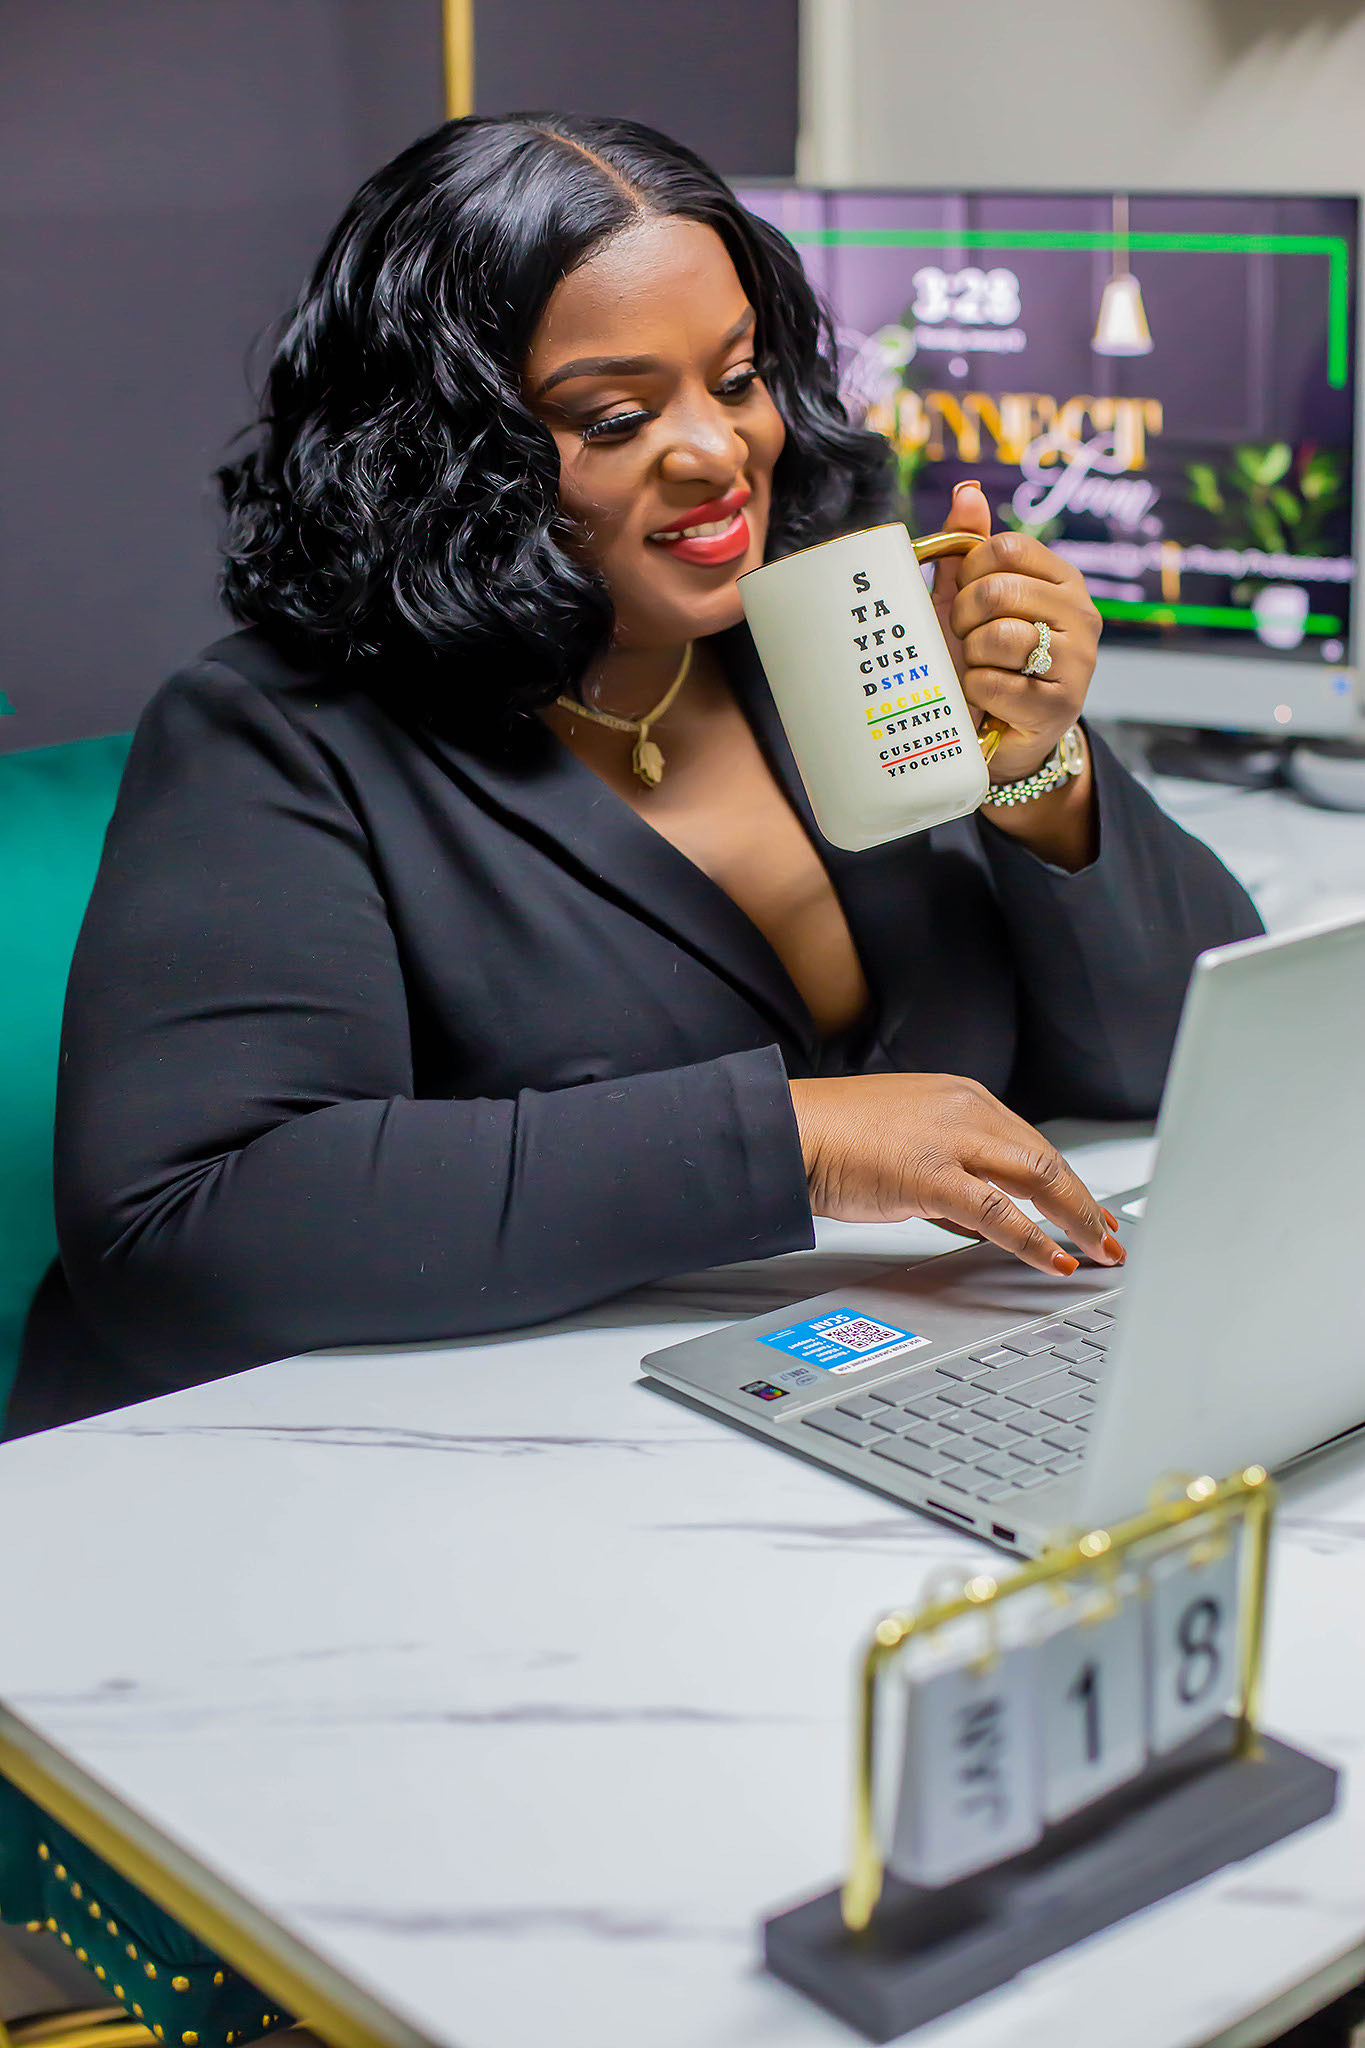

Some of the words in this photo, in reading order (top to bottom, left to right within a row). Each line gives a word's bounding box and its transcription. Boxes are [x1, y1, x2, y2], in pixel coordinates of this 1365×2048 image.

[852, 572, 871, 593] S
[853, 624, 906, 652] YFO
[859, 645, 919, 675] CUSE
[862, 664, 930, 697] DSTAY
[864, 685, 943, 721] FOCUSE
[879, 727, 959, 761] CUSEDSTA
[887, 746, 963, 778] YFOCUSED
[808, 1313, 851, 1331] SCAN
[1177, 1597, 1220, 1704] 8
[1067, 1658, 1103, 1763] 1
